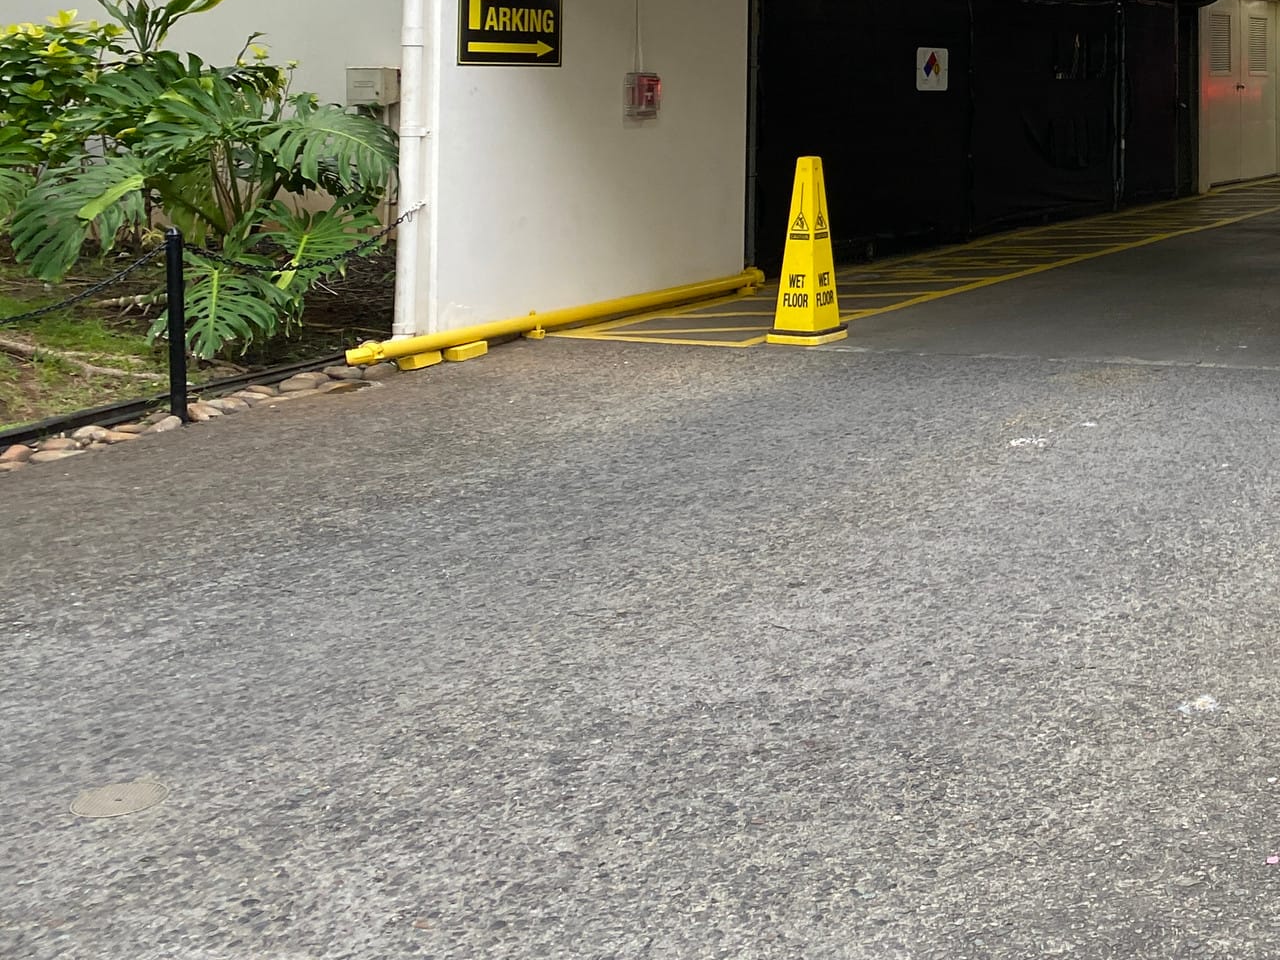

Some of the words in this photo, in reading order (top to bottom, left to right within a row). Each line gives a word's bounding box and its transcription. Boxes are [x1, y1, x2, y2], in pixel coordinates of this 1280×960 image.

[789, 274, 806, 288] WET
[818, 272, 830, 287] WET
[783, 293, 808, 308] FLOOR
[816, 290, 834, 307] FLOOR
